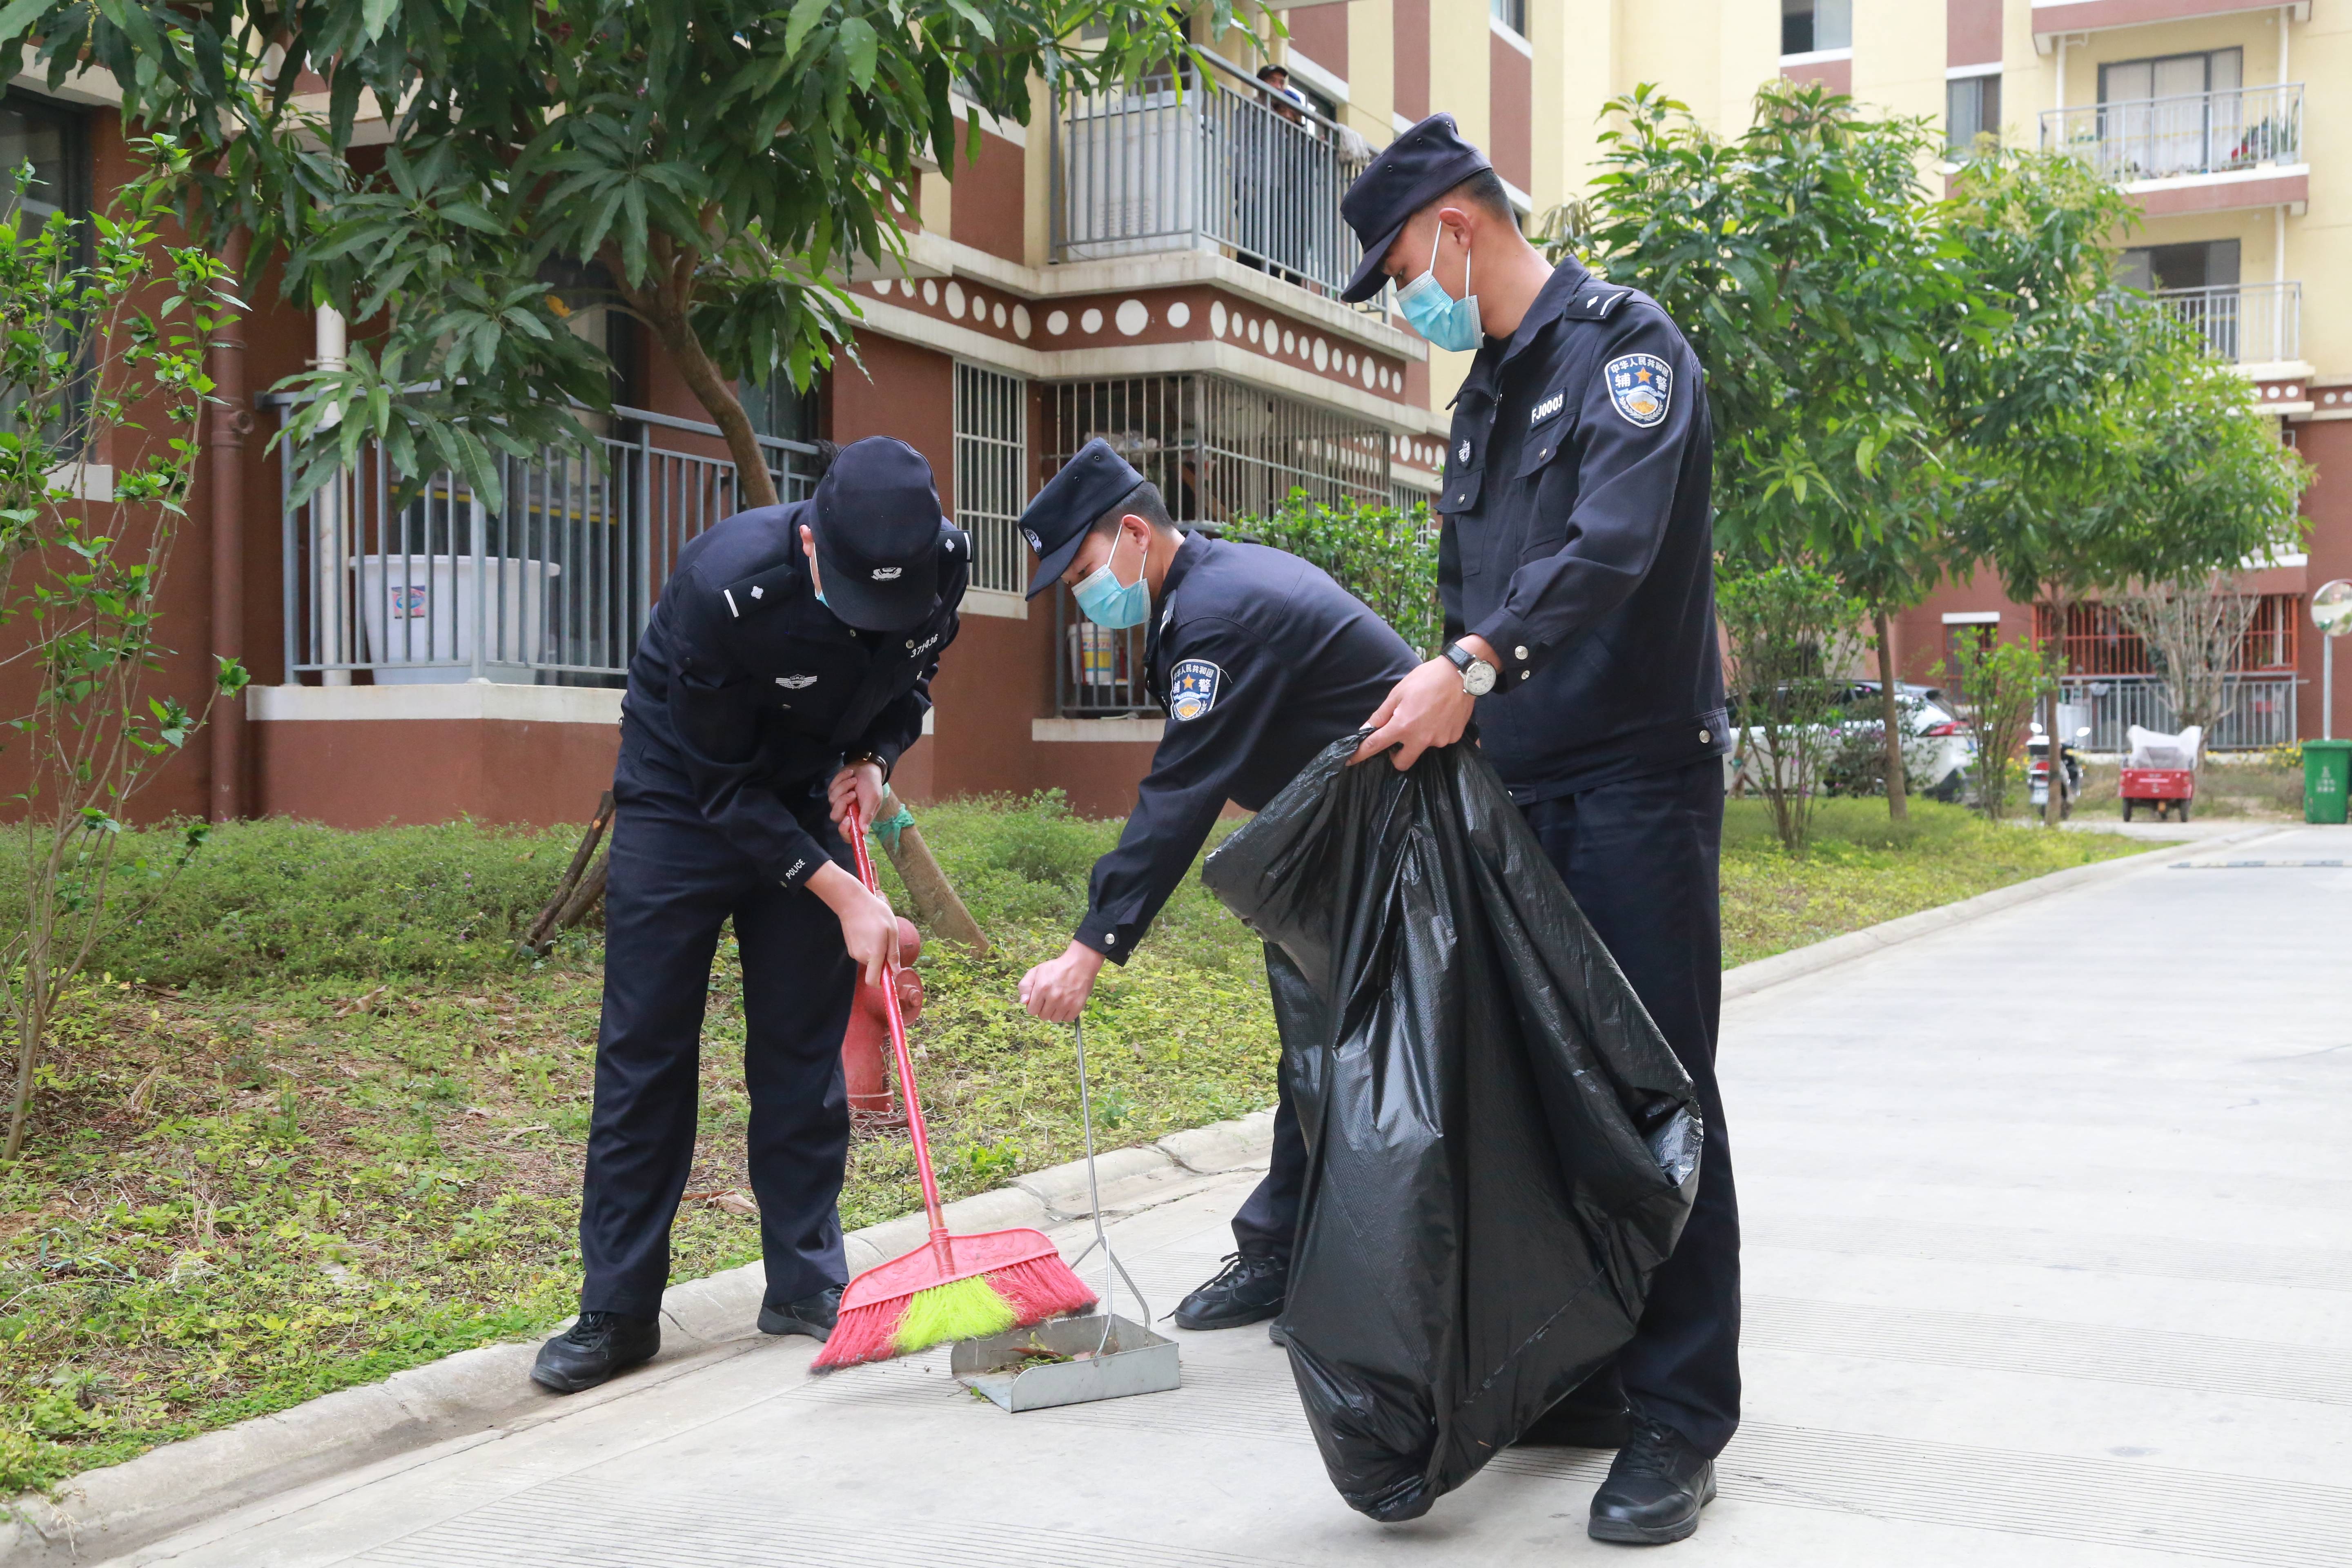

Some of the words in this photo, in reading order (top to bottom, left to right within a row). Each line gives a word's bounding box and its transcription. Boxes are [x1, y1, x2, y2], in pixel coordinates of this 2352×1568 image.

[1610, 356, 1669, 376] 中华人民共和国
[1615, 373, 1631, 388] 辅
[1655, 375, 1667, 392] 警
[1531, 394, 1563, 424] FJ0003
[910, 633, 938, 658] 371436
[1174, 664, 1215, 680] 中华人民共和国
[1198, 679, 1211, 692] 警
[785, 858, 806, 880] POLICE
